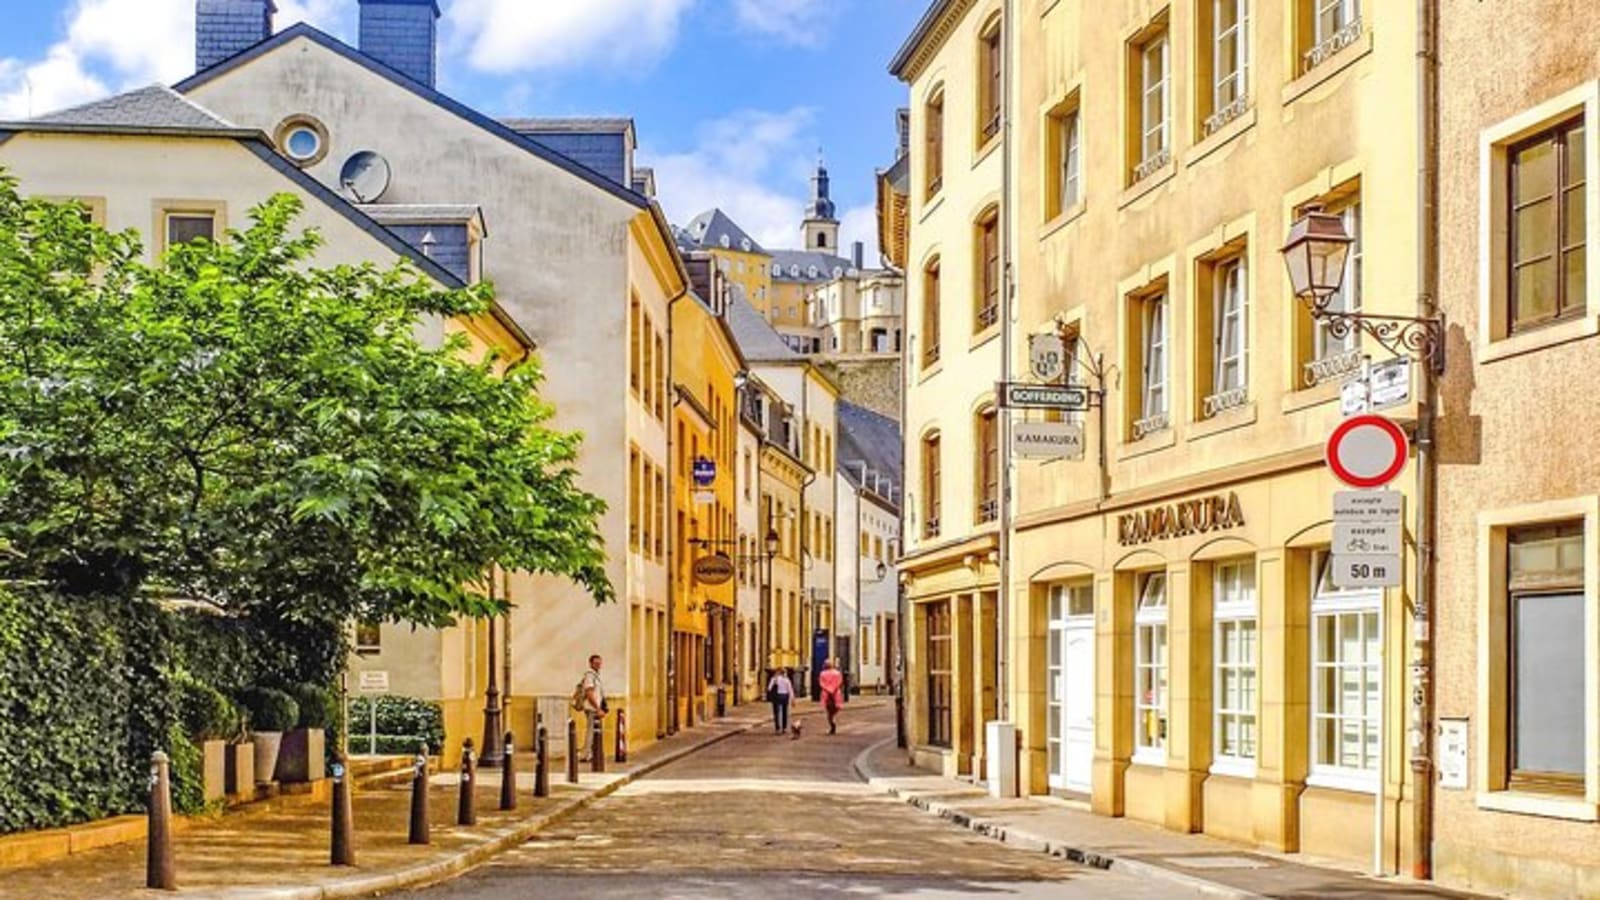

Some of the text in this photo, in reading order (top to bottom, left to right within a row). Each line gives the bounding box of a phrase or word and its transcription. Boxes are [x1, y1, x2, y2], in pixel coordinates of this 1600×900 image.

[1012, 390, 1082, 403] BOFFERDING
[1016, 434, 1079, 445] KAMAKURA
[1118, 491, 1245, 545] KAMAKURA
[1350, 563, 1386, 578] 50 m
